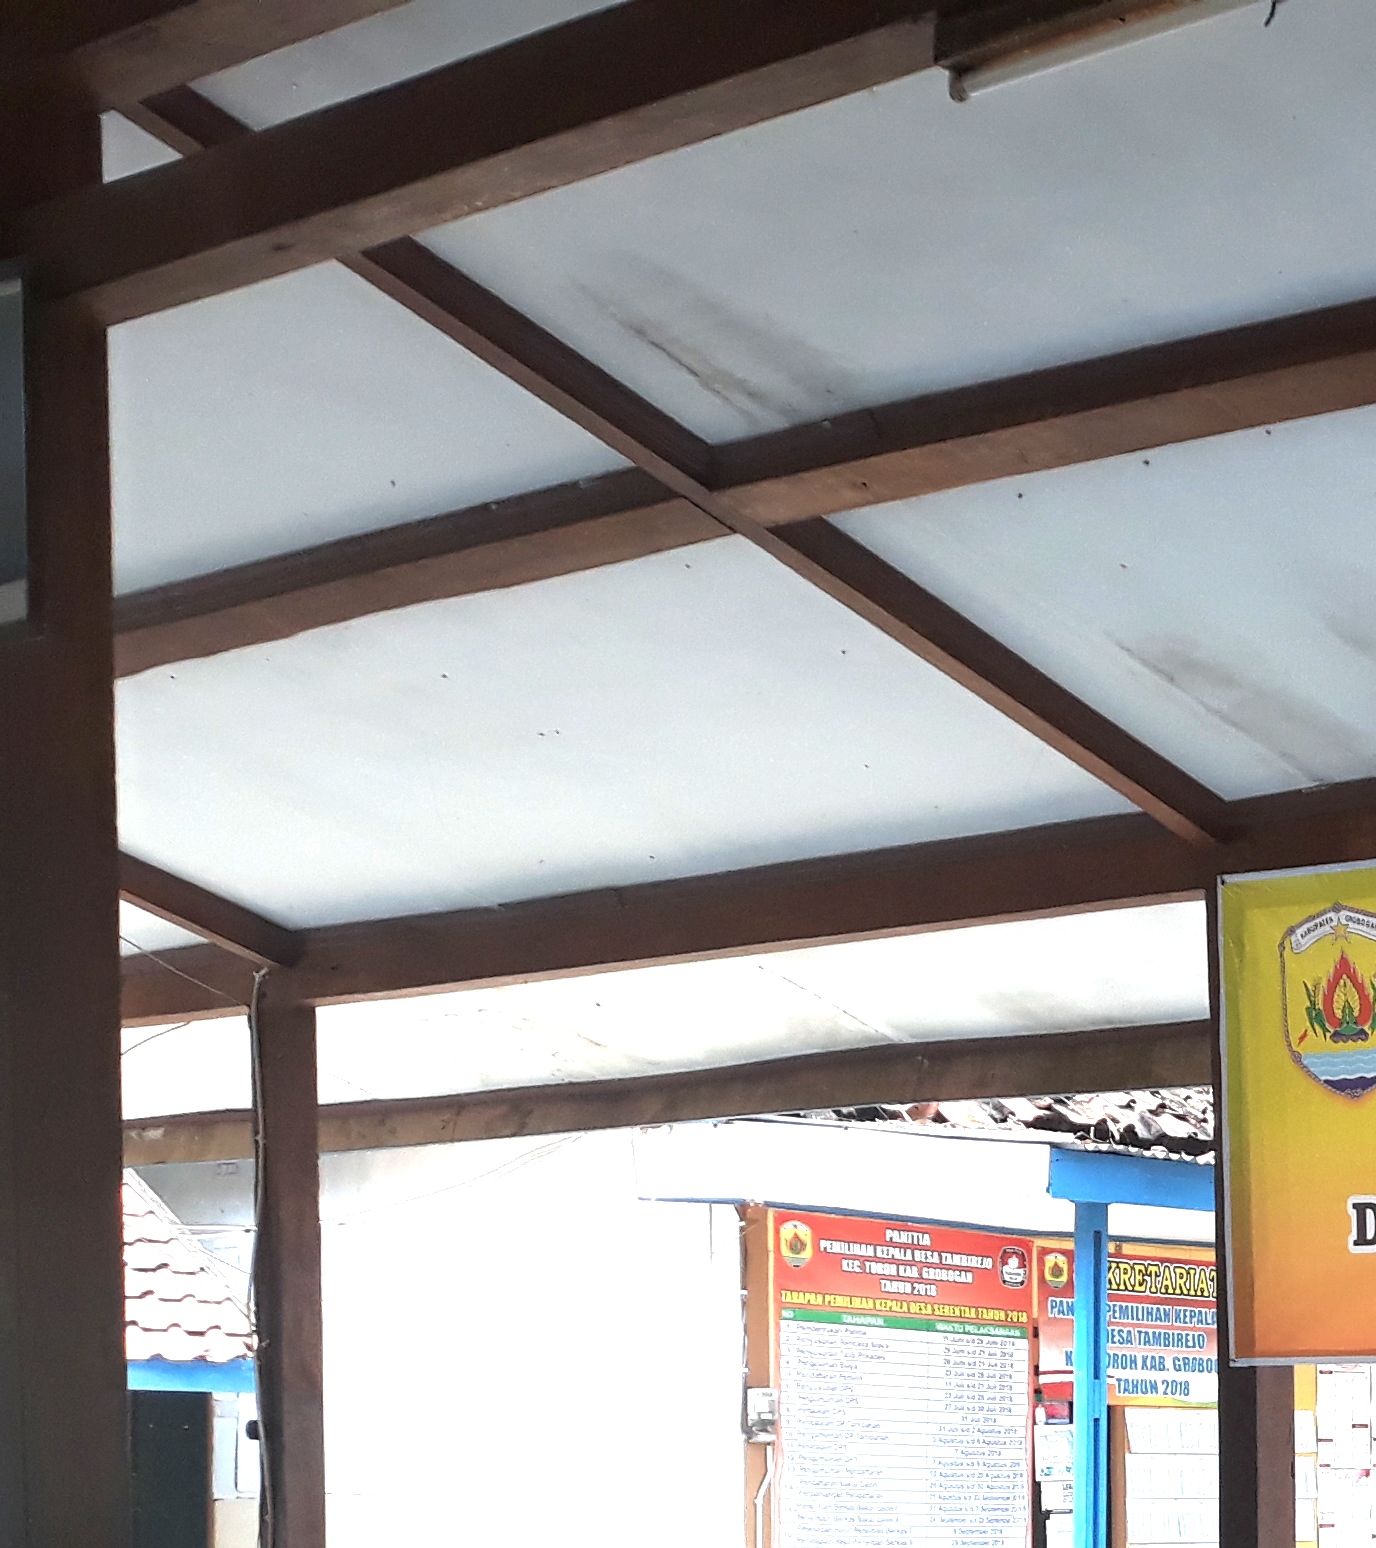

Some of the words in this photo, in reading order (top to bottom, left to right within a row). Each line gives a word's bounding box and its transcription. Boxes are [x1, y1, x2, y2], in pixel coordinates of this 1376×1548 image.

[885, 1229, 931, 1246] PANITIA
[820, 1240, 874, 1257] PEMILIHAN
[876, 1246, 912, 1261] KEPALA
[914, 1250, 939, 1264] DESA
[941, 1253, 993, 1270] TAMBIREJO
[865, 1263, 896, 1276] TOROH
[922, 1268, 973, 1283] GROBOGAN
[1107, 1260, 1217, 1298] KRETARIAT
[880, 1279, 911, 1294] TAHUN
[914, 1282, 937, 1296] 2018
[781, 1290, 822, 1306] TAHAPAN
[825, 1294, 873, 1310] PEMILIHAN
[875, 1298, 908, 1313] KEPALA
[910, 1301, 932, 1315] DESA
[934, 1304, 976, 1319] SERENTAK
[978, 1307, 1005, 1321] TAHUN
[1007, 1310, 1028, 1324] 2018
[1137, 1330, 1206, 1349] TAMBIREJO
[1107, 1353, 1138, 1371] ROH
[1141, 1354, 1170, 1372] KAB.
[1173, 1356, 1218, 1374] GROBO
[1116, 1377, 1159, 1395] TAHUN
[1162, 1379, 1190, 1397] 2018
